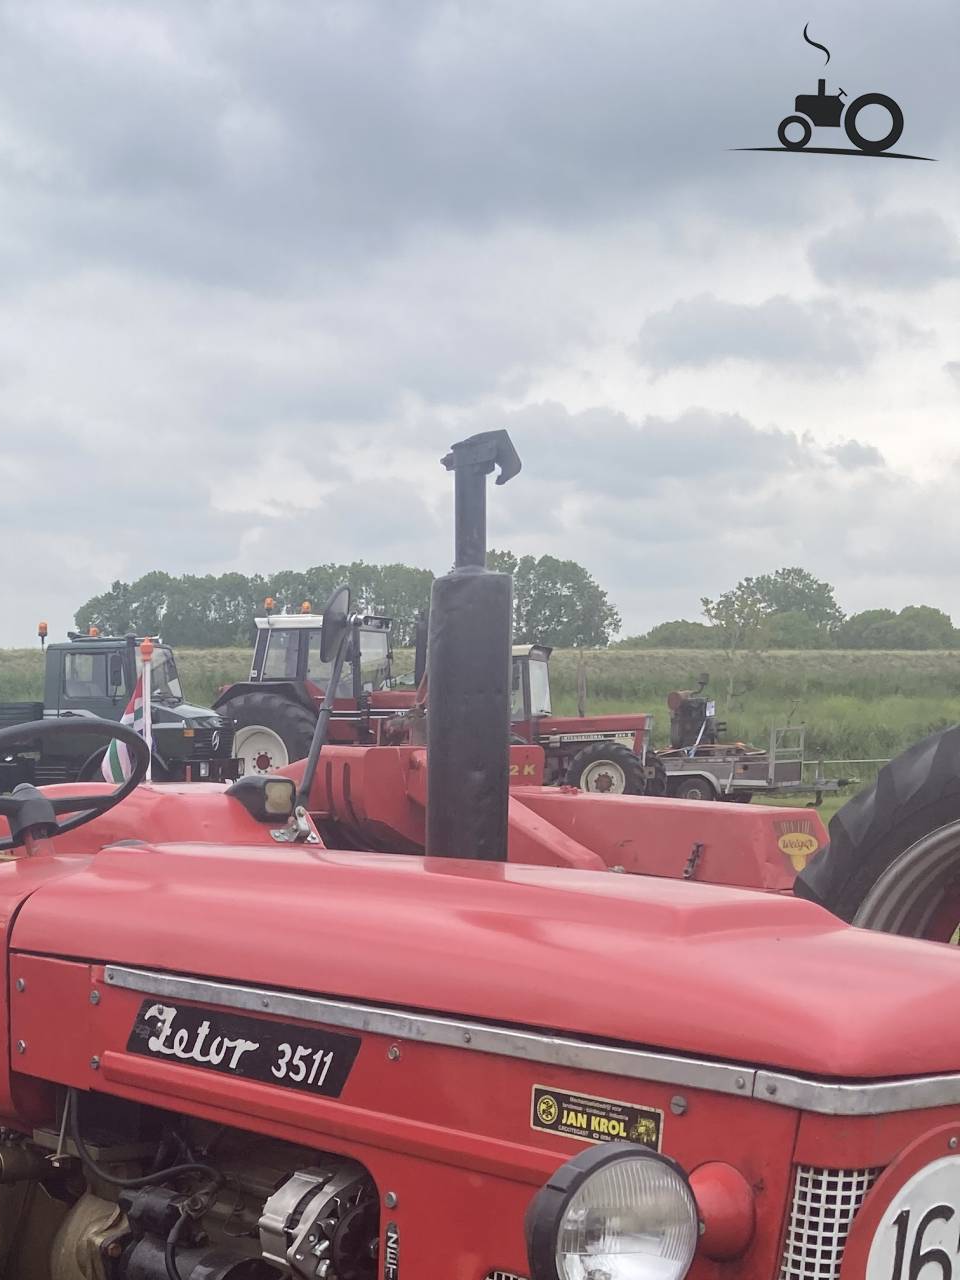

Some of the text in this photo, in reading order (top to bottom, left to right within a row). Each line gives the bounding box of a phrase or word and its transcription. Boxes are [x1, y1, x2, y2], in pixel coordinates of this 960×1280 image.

[144, 1003, 334, 1087] Zetor 3511
[561, 1109, 587, 1129] JAN
[590, 1115, 627, 1137] KROL
